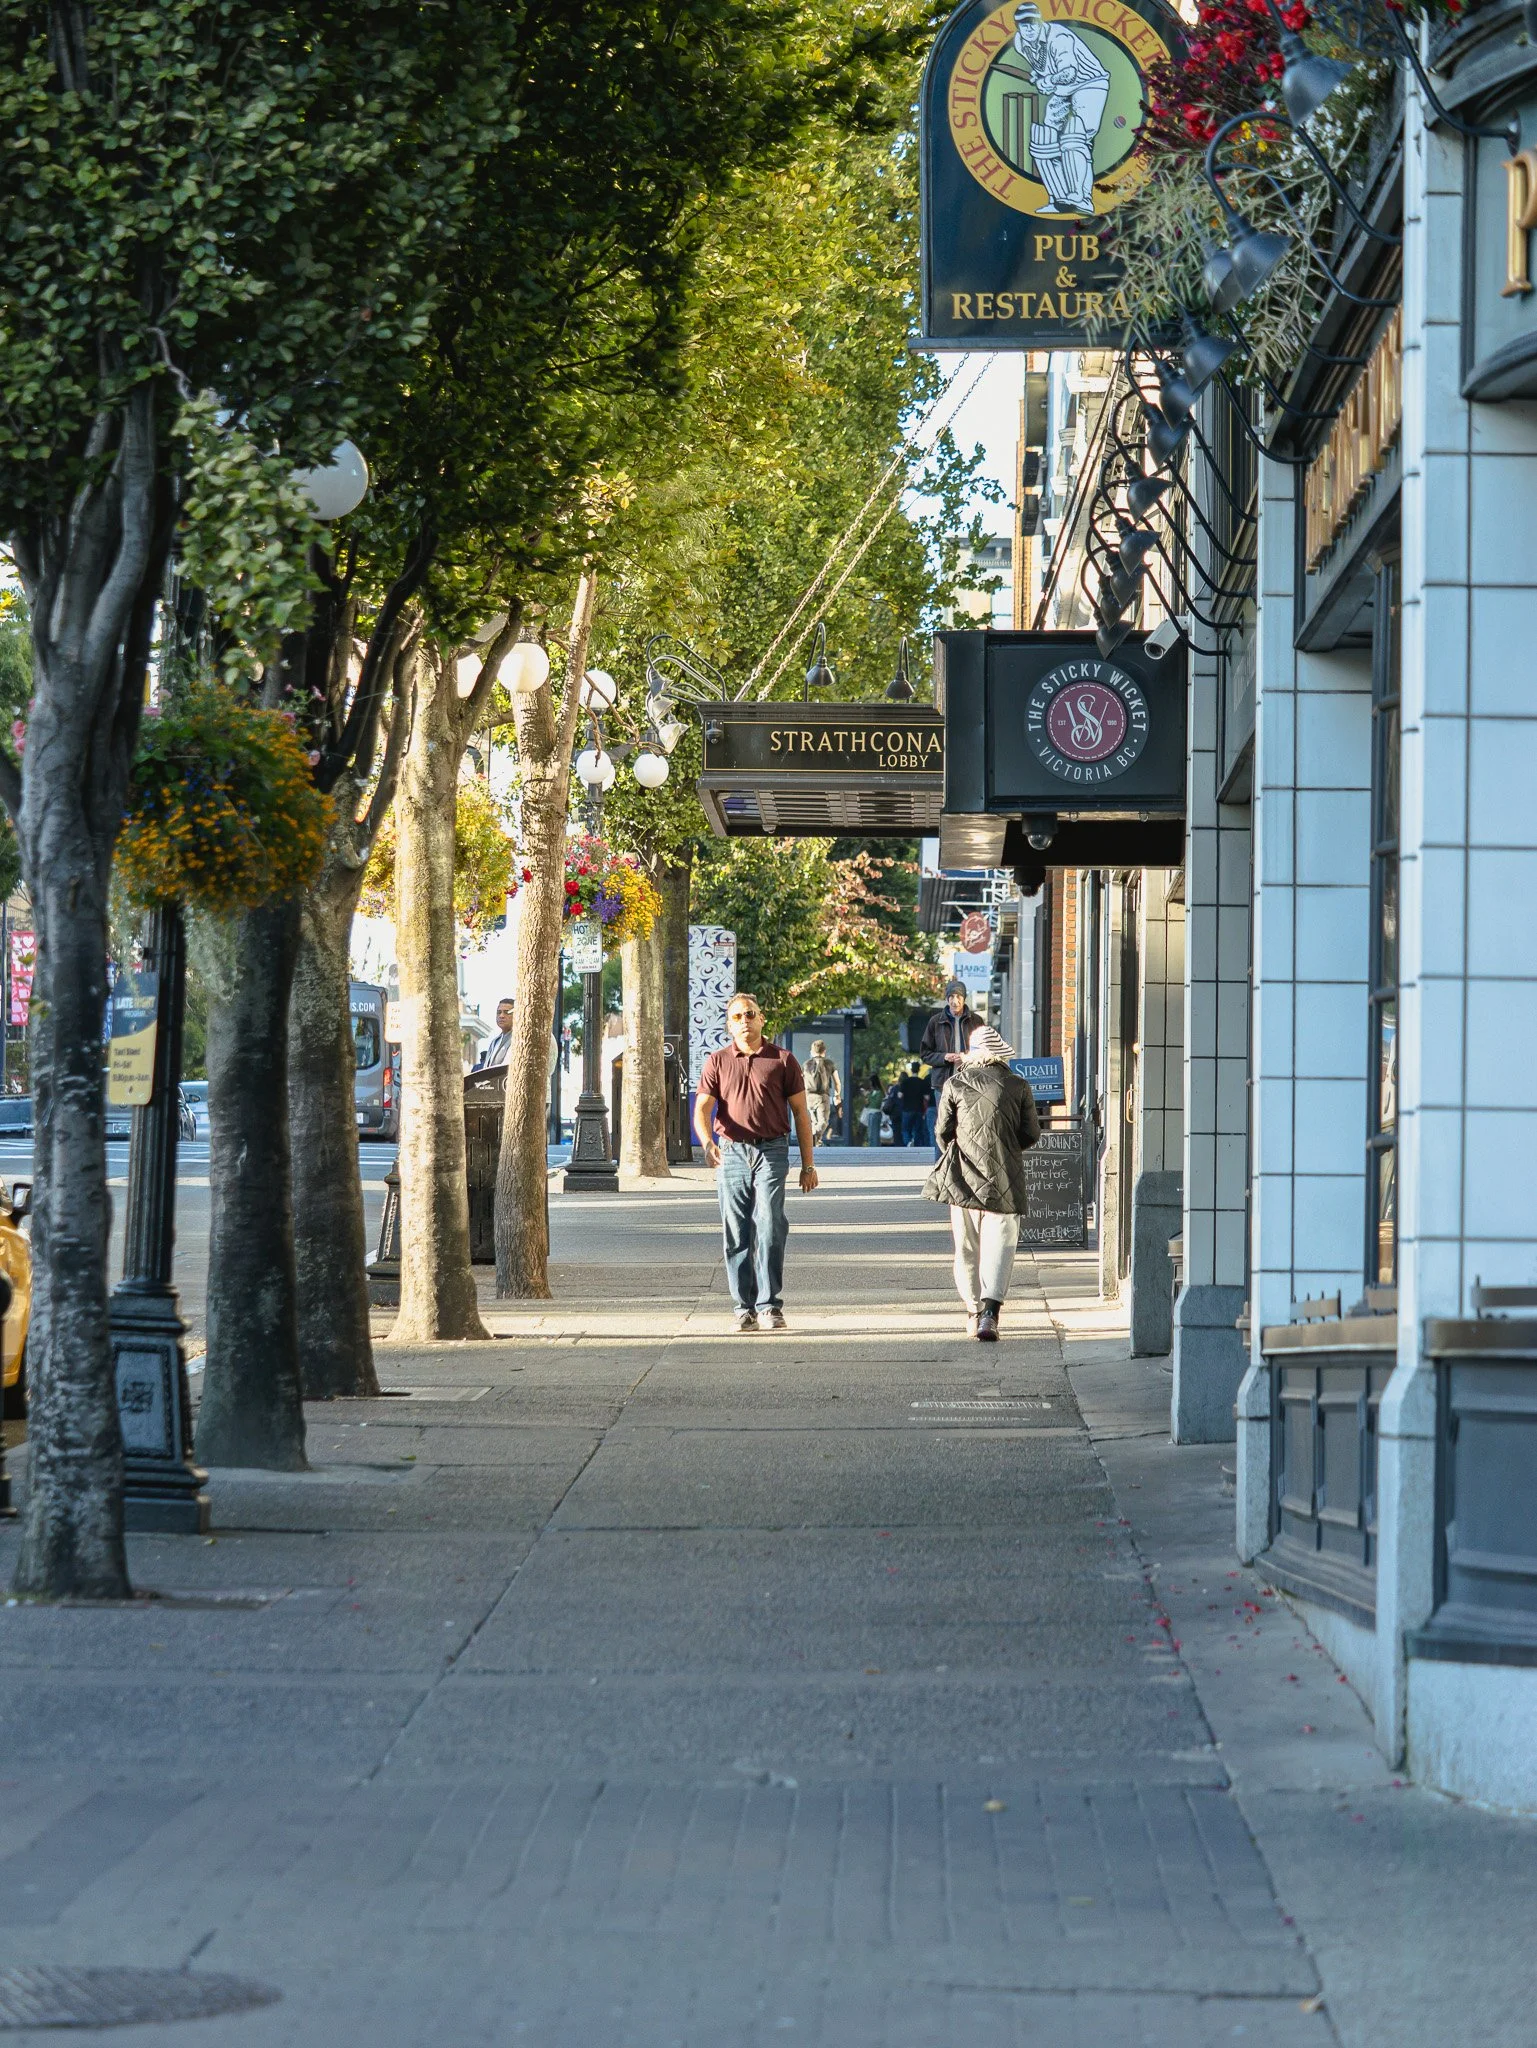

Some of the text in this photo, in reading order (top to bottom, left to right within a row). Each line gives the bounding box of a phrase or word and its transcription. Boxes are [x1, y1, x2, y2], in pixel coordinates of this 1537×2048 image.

[952, 0, 1172, 201] THE STICKY WICKET
[1033, 234, 1100, 262] PUB
[1055, 265, 1078, 288] &
[951, 292, 1168, 320] RESTAURA
[1028, 663, 1147, 731] THE STICKY WICKET
[770, 730, 943, 753] STRATHCONA
[879, 754, 928, 768] LOBBY
[1039, 746, 1136, 781] VICTORIA BC
[577, 936, 598, 947] ZONE
[351, 1002, 376, 1012] S.COM
[1015, 1063, 1058, 1078] STRATH
